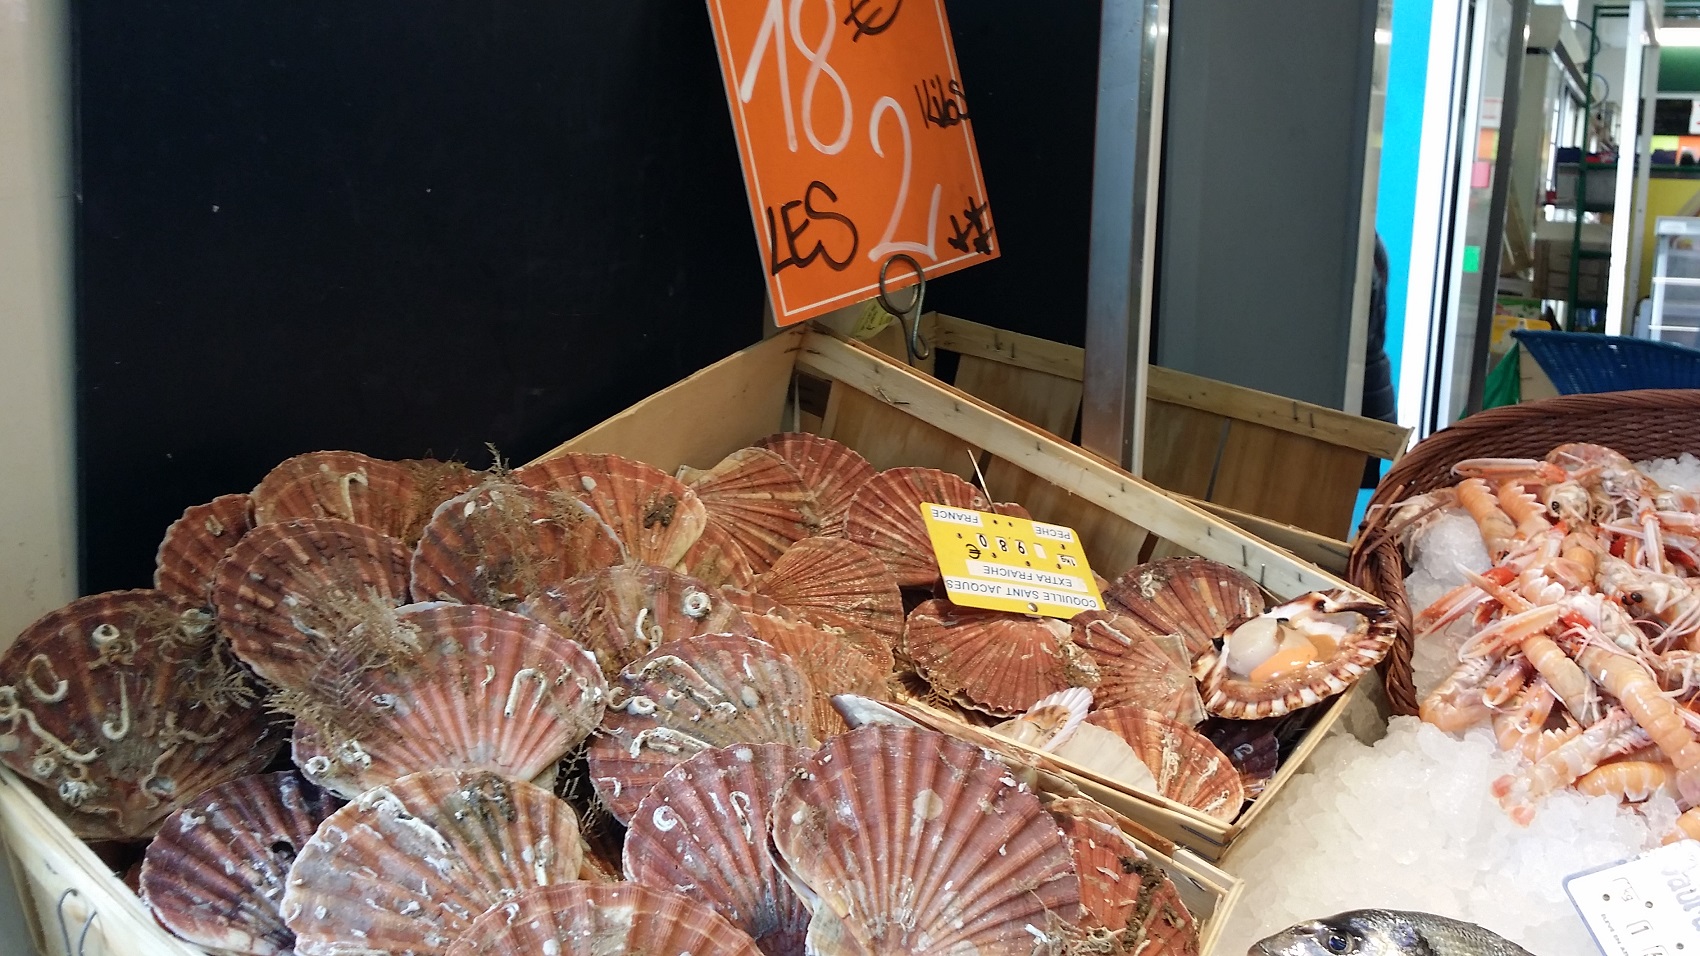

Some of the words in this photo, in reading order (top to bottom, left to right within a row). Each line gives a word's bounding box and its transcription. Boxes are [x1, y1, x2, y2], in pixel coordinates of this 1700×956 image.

[740, 0, 853, 155] 18
[767, 181, 859, 276] LES
[932, 509, 978, 524] FRANCE
[1036, 526, 1071, 540] PECHE
[965, 543, 982, 560] €
[983, 565, 1033, 582] FRAICHE
[1036, 574, 1073, 588] EXTRA
[947, 579, 1002, 594] JACQUES
[1005, 587, 1039, 600] SAINT
[1043, 591, 1097, 608] COQUILLE
